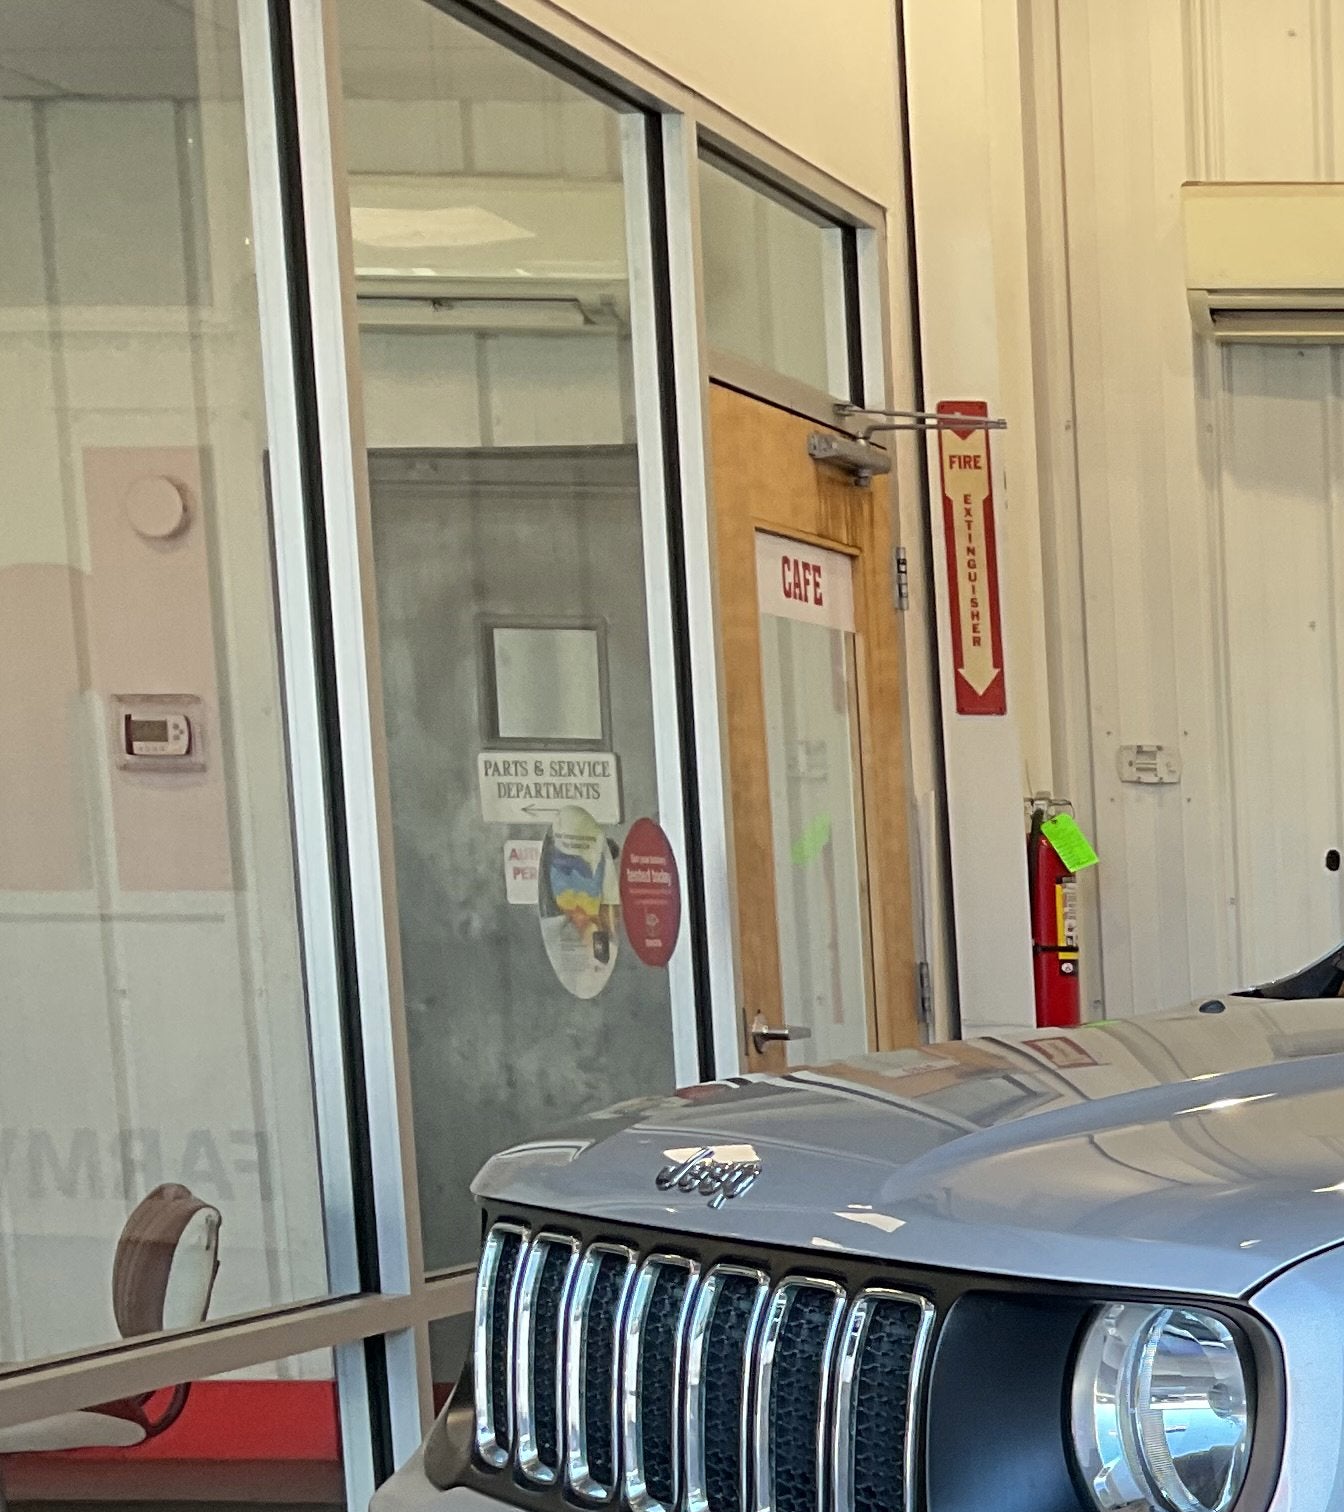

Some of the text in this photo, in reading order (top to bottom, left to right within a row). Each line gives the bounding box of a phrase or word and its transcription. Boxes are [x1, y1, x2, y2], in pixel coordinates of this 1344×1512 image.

[949, 455, 982, 470] FIRE
[782, 555, 823, 606] CAFE
[963, 494, 981, 647] EXTINGUISHER
[483, 760, 611, 777] PARTS & SERVICE
[497, 782, 601, 800] DEPARTMENTS
[655, 1146, 762, 1209] Jeep
